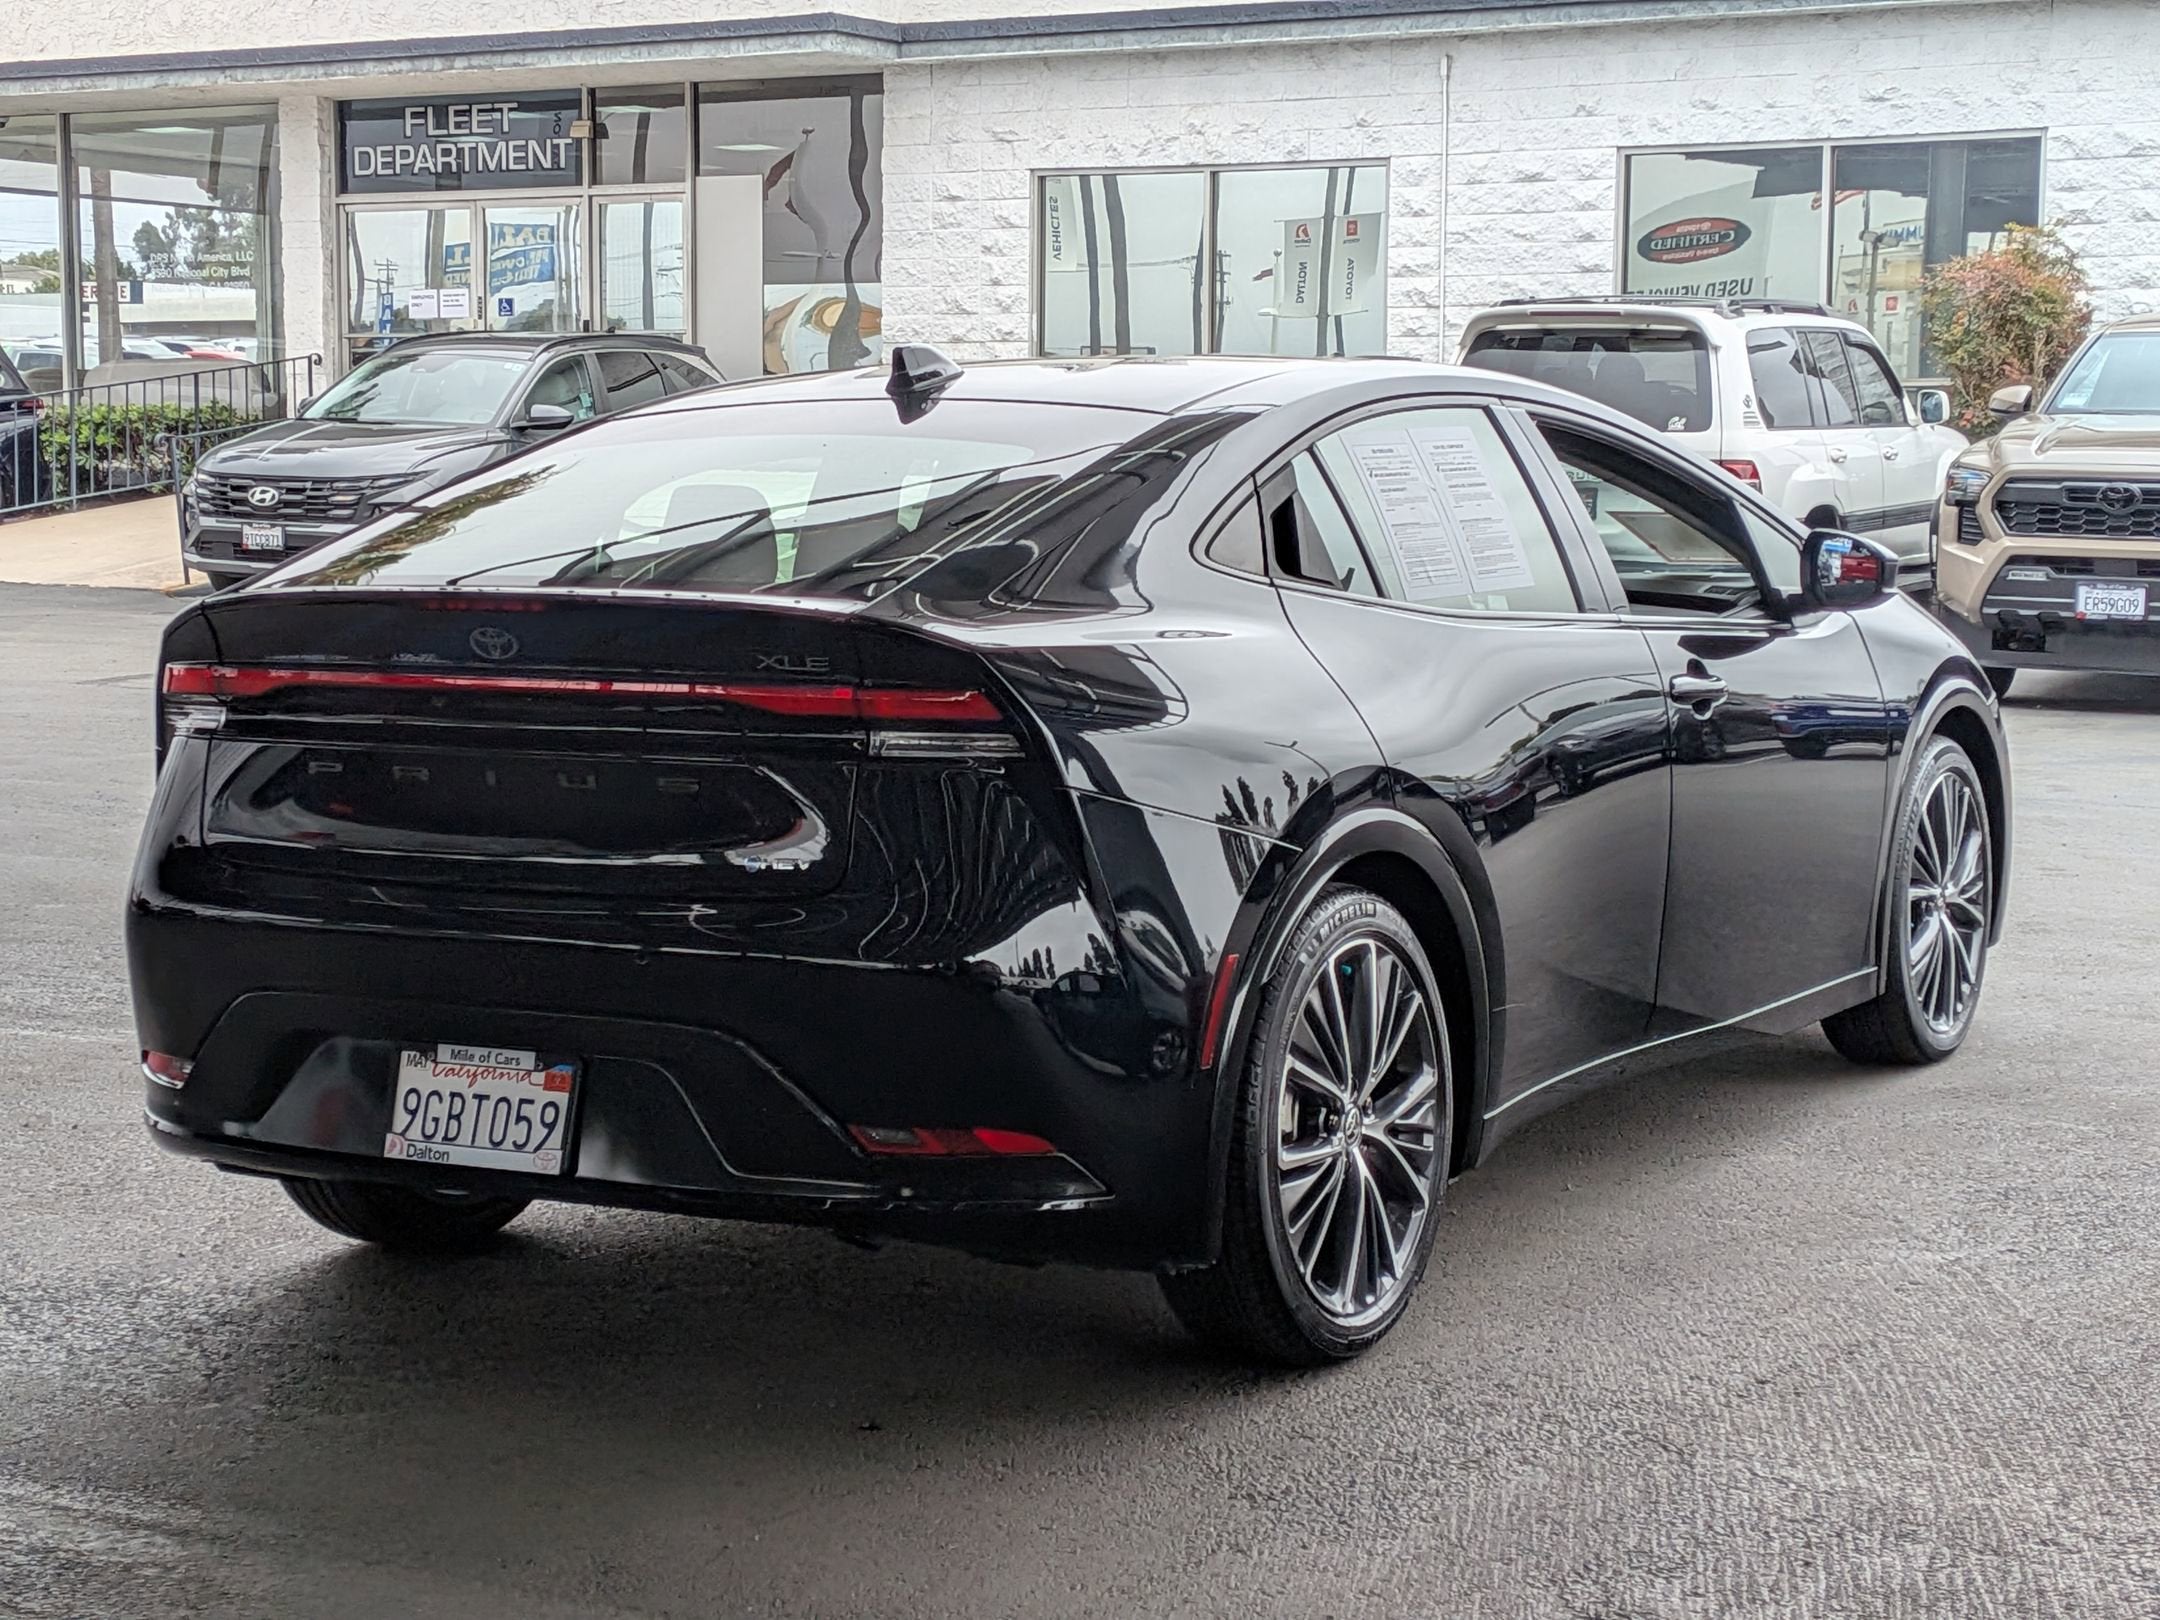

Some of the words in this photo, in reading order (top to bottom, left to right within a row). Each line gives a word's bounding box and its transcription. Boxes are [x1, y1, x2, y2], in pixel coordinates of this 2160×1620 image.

[403, 102, 519, 138] FLEET
[352, 137, 573, 177] DEPARTMENT
[235, 249, 254, 262] LLC
[210, 265, 229, 279] City
[231, 264, 250, 277] Blvd
[2084, 596, 2140, 613] ER59G09
[756, 653, 830, 672] XLE
[307, 760, 699, 793] PRIUS
[1319, 902, 1375, 942] MICHELIN
[406, 1053, 429, 1069] MAY
[450, 1048, 475, 1063] Mile
[478, 1052, 492, 1064] of
[495, 1052, 521, 1067] Cars
[432, 1063, 542, 1088] California
[402, 1087, 560, 1152] 9GBT059
[405, 1143, 450, 1163] Dalton
